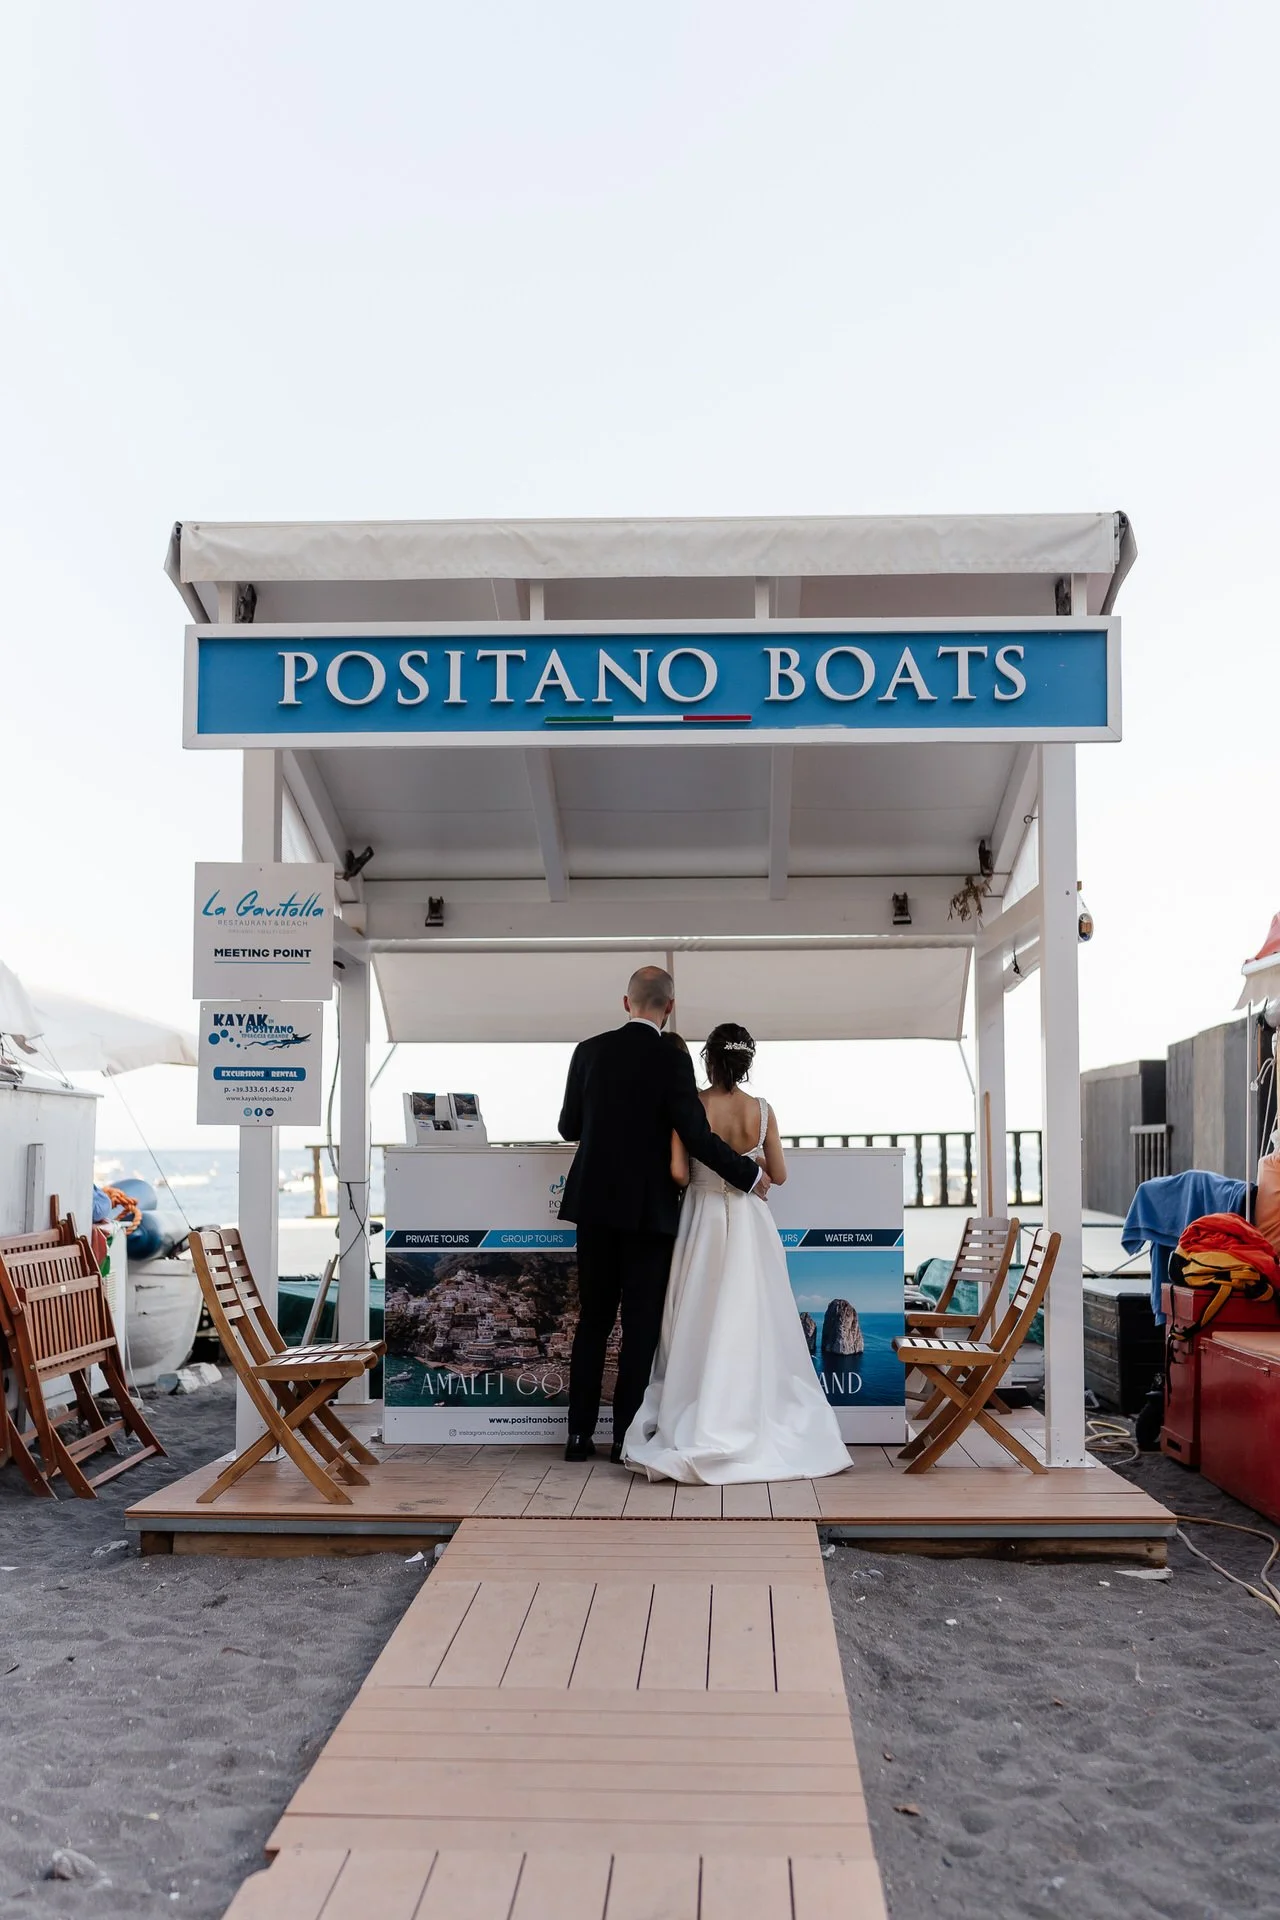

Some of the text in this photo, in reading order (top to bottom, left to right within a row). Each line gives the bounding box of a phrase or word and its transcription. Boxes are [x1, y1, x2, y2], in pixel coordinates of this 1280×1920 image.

[277, 644, 1028, 707] POSITANO BOATS
[201, 889, 227, 917] La
[213, 948, 312, 958] MEETING POINT
[213, 1013, 268, 1027] KAYAK
[245, 1025, 294, 1034] POSITANO
[221, 1069, 264, 1078] EXCURSIONS
[271, 1070, 298, 1078] RENTAL
[225, 1095, 292, 1103] www.kayakinpositano.it
[405, 1235, 470, 1243] PRIVATE TOURS
[501, 1234, 564, 1243] GROUP TOURS
[780, 1234, 798, 1242] URS
[824, 1233, 873, 1242] WATER TAXI
[420, 1372, 504, 1396] AMALFI
[488, 1415, 568, 1425] www.positanoboat
